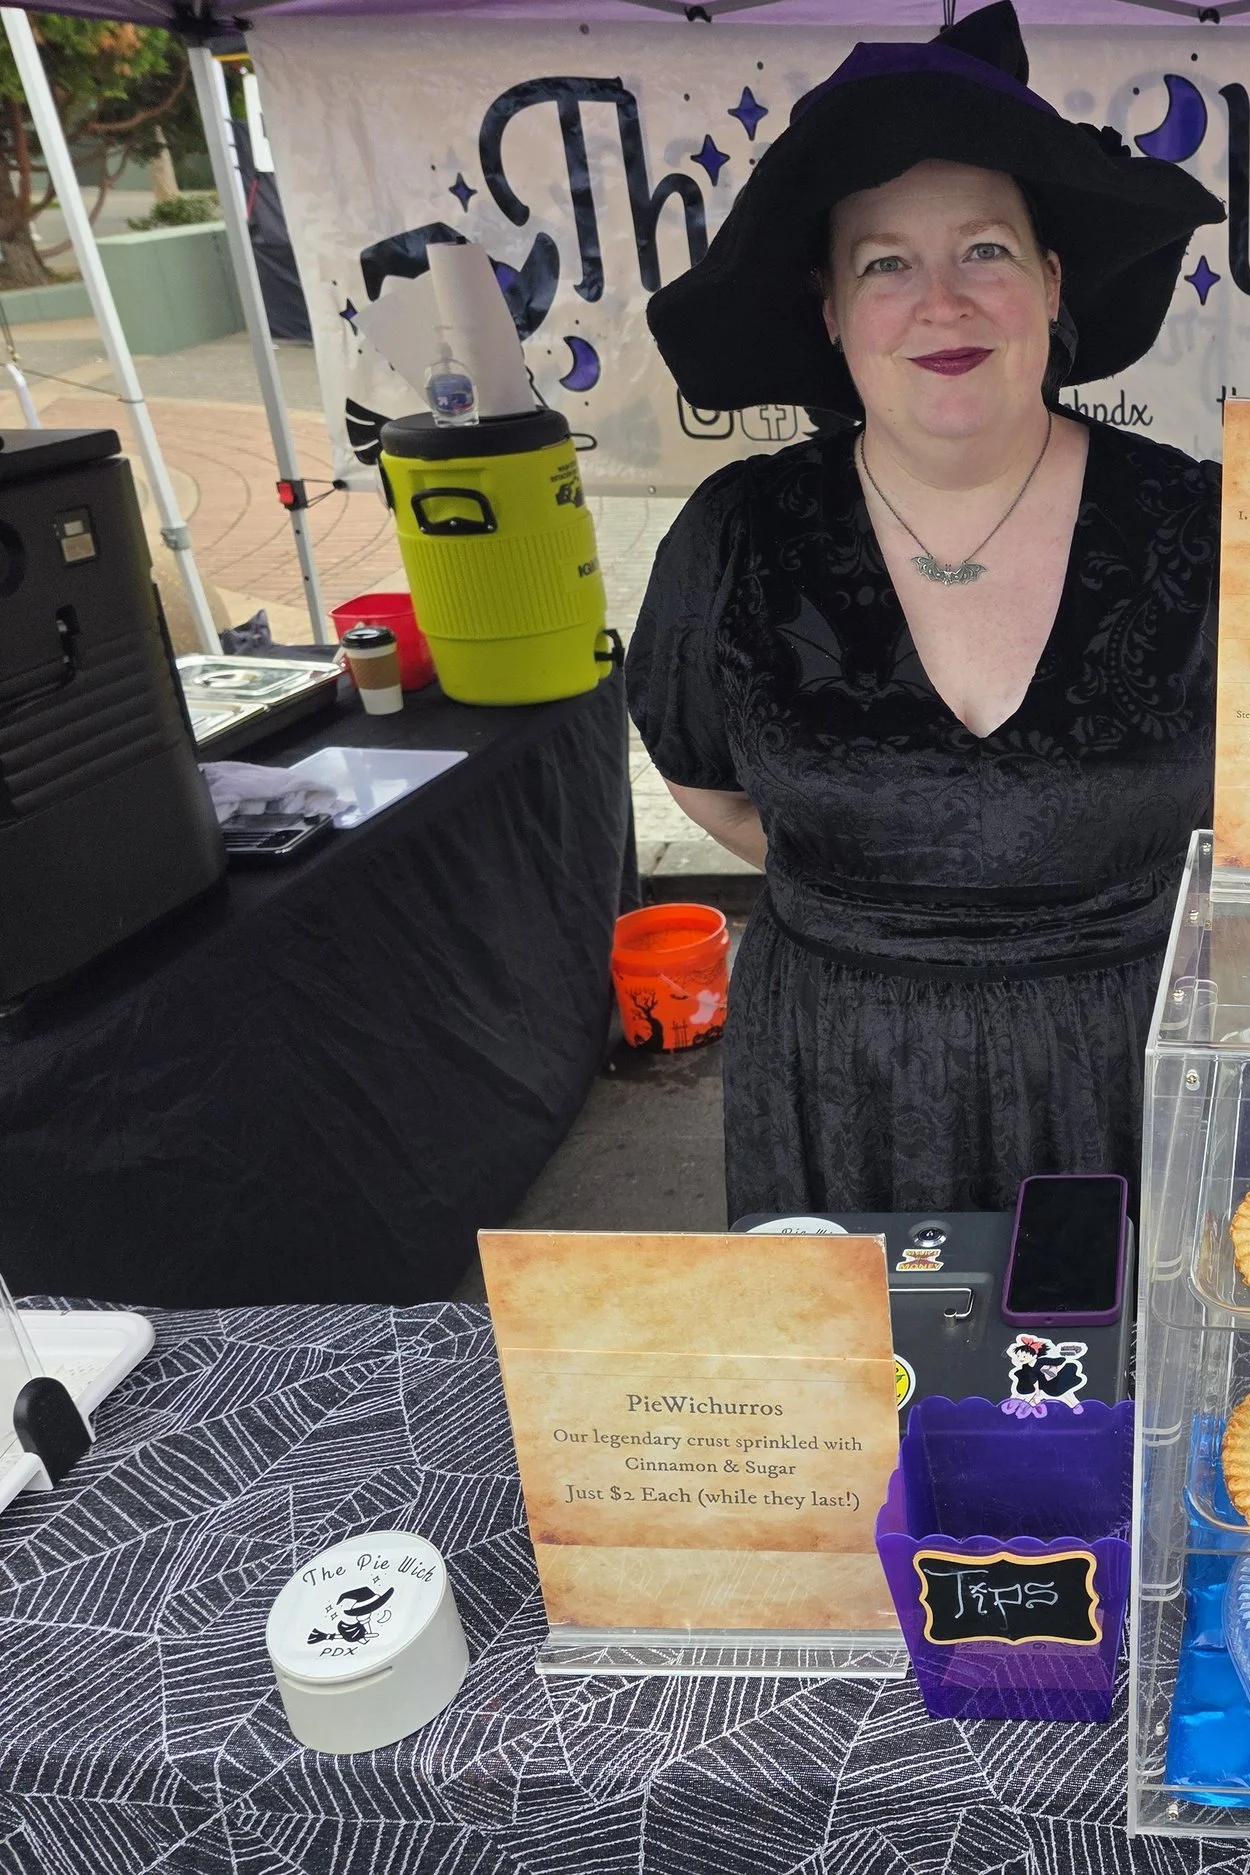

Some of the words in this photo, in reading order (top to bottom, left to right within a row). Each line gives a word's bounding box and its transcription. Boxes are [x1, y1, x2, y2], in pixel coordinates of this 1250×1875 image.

[479, 75, 709, 303] Th
[626, 1394, 783, 1416] PieWichurros
[553, 1429, 589, 1443] Our
[592, 1428, 682, 1450] legendary
[687, 1437, 731, 1447] crust
[735, 1434, 819, 1453] sprinkled
[823, 1437, 862, 1451] with
[625, 1457, 718, 1473] Cinnamon
[723, 1459, 740, 1473] &
[745, 1460, 796, 1479] Sugar
[565, 1484, 604, 1503] Just
[610, 1485, 635, 1501] $2
[640, 1487, 692, 1503] Each
[698, 1488, 757, 1508] (while
[763, 1490, 806, 1510] they
[811, 1490, 860, 1512] last!)
[302, 1566, 346, 1586] The
[357, 1553, 390, 1571] Pie
[397, 1555, 436, 1582] Wich
[319, 1646, 358, 1657] PDX
